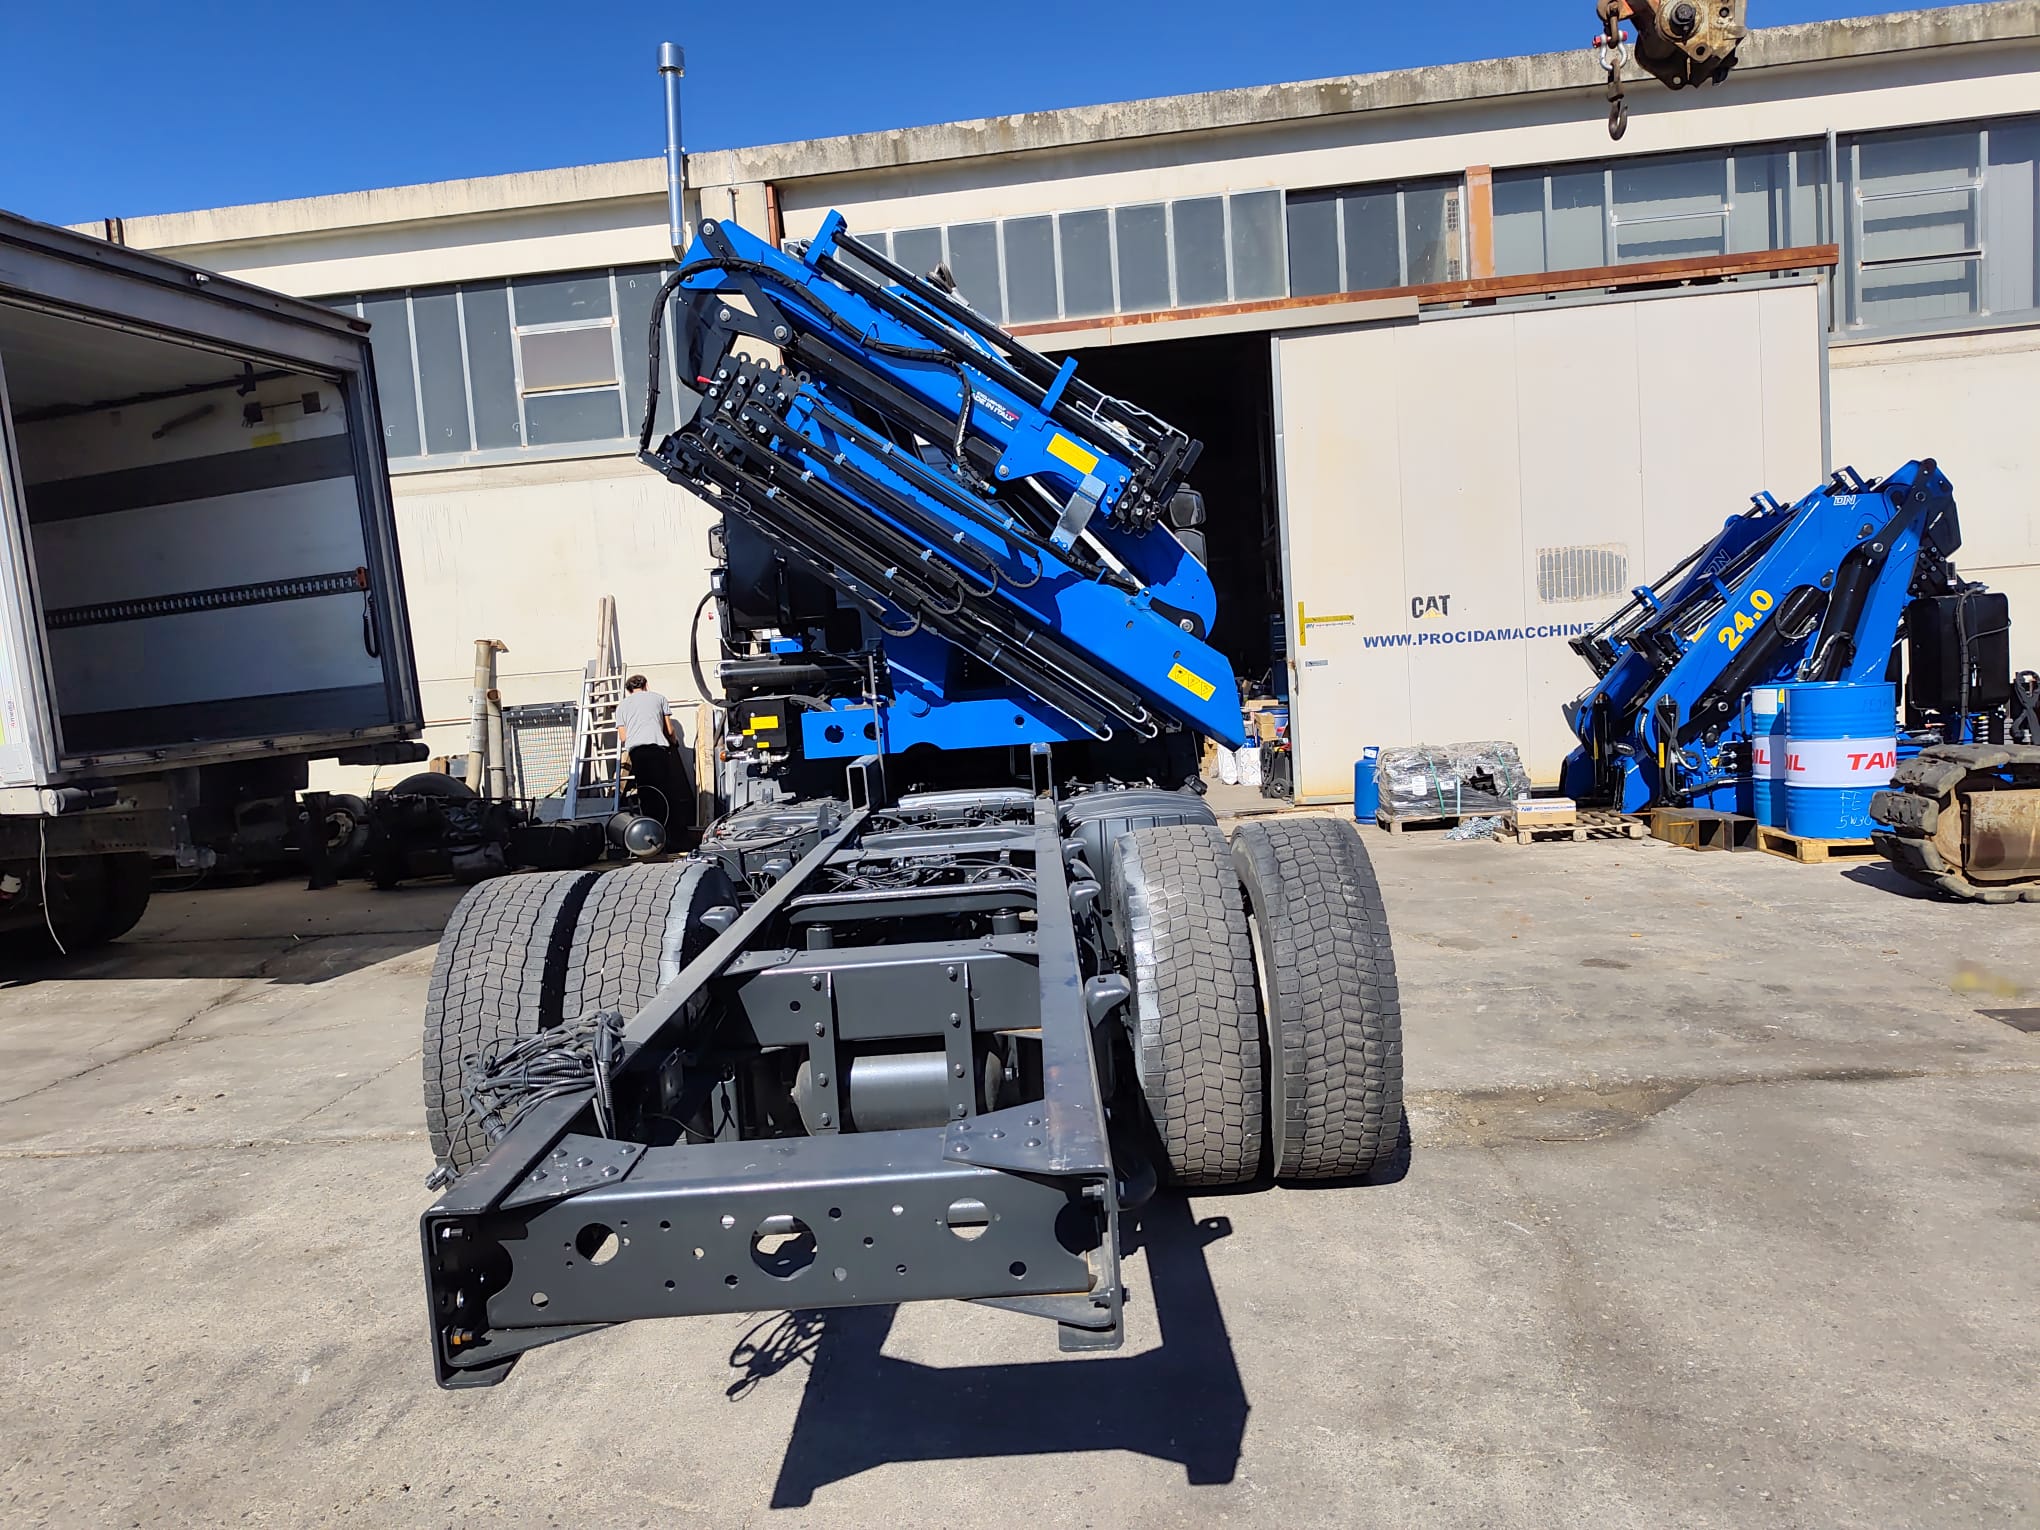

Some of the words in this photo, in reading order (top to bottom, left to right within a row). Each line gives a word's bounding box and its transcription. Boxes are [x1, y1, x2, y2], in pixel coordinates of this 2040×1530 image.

[994, 407, 1015, 422] ITALY
[1411, 594, 1451, 619] CAT
[1718, 589, 1774, 652] 24.0
[1752, 749, 1771, 765] IL
